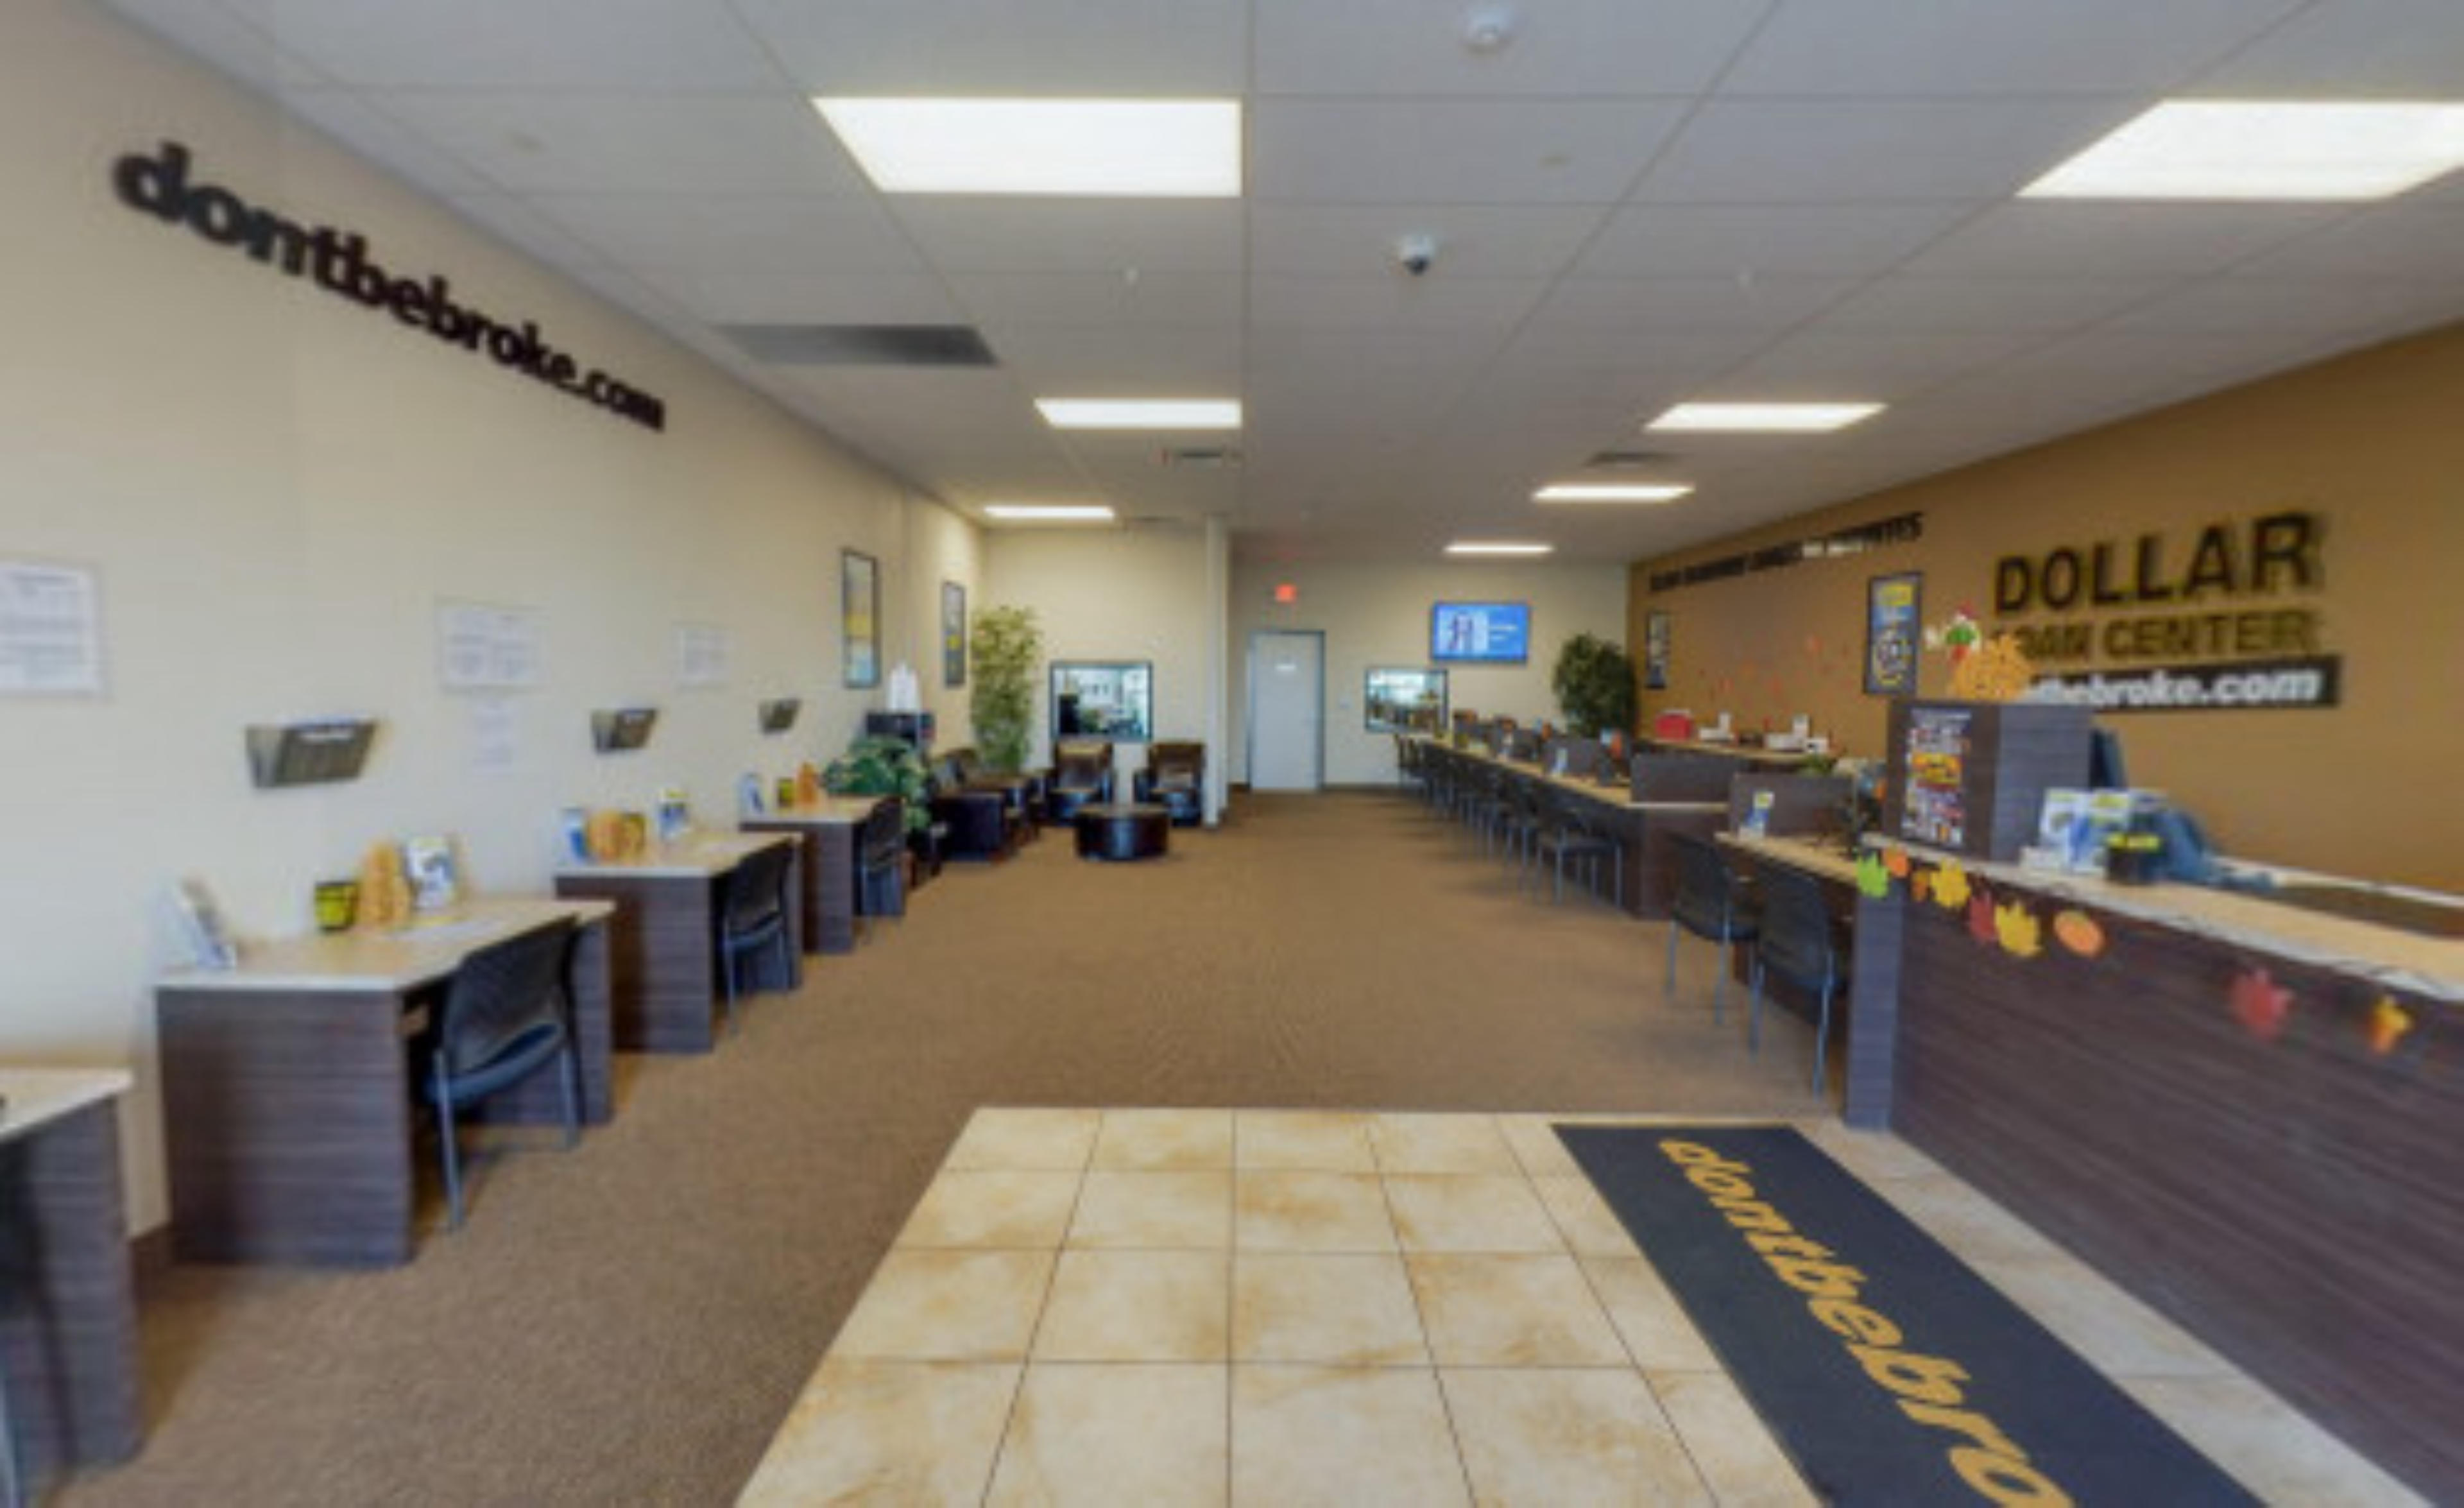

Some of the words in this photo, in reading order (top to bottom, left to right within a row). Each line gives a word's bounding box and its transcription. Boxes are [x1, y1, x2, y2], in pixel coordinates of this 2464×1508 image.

[113, 140, 666, 431] dontbebroke.com
[1994, 513, 2318, 615] DOLLAR
[1994, 622, 2092, 661] OAN
[2102, 610, 2320, 660] CENTER
